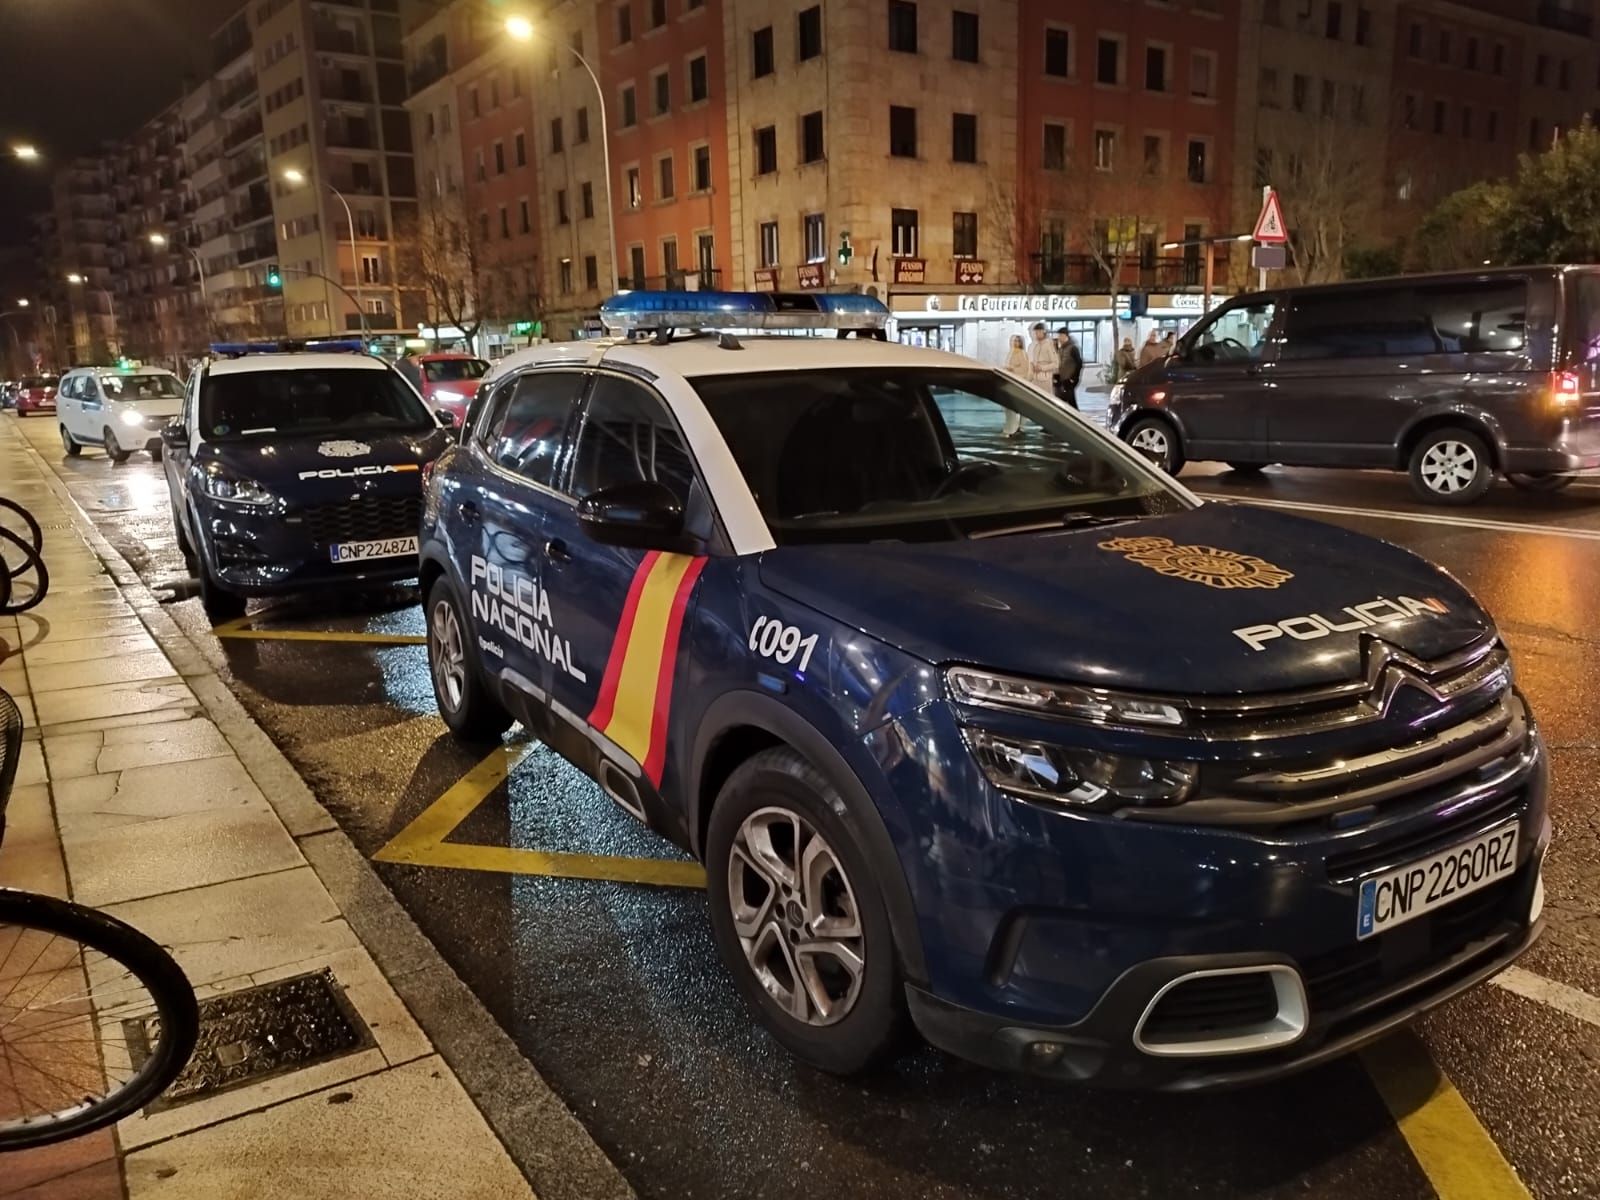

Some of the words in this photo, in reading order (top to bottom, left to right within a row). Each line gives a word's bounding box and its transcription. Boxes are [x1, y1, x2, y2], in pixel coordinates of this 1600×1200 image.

[962, 298, 976, 311] LA
[1035, 299, 1049, 311] DE
[1052, 297, 1079, 311] PACO
[339, 538, 417, 560] CNP2248ZA
[471, 588, 587, 684] NACIONAL
[759, 619, 819, 673] 091
[1363, 914, 1371, 927] E
